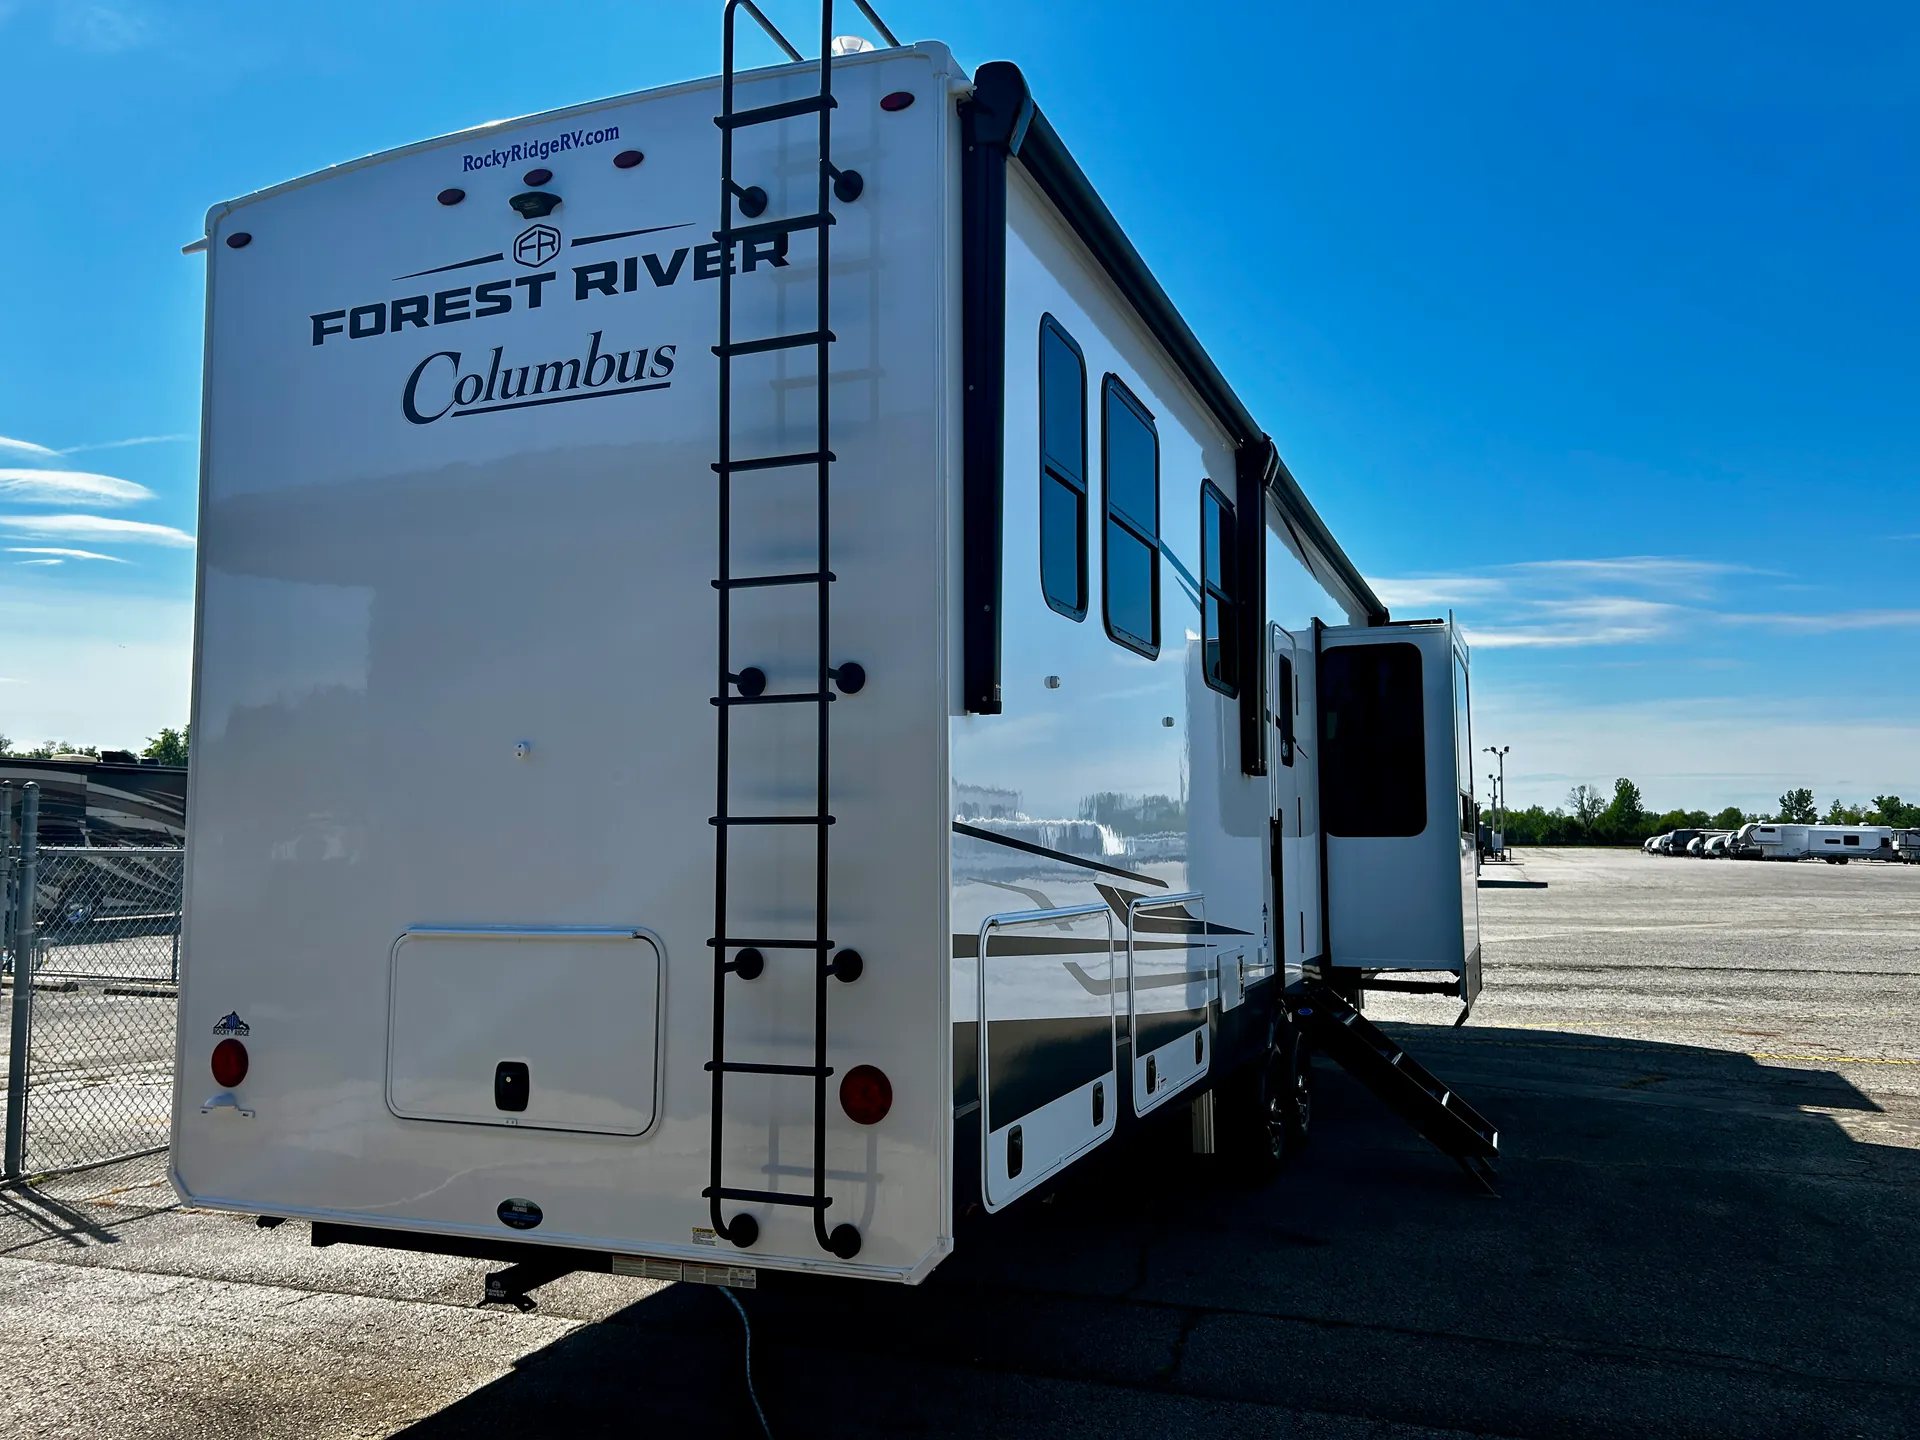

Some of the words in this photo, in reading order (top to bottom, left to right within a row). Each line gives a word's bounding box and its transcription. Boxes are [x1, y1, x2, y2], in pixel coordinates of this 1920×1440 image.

[463, 126, 620, 172] RockyRidgeRV.com
[309, 271, 557, 346] FOREST
[571, 231, 790, 301] RIVER
[402, 330, 677, 425] Columbus
